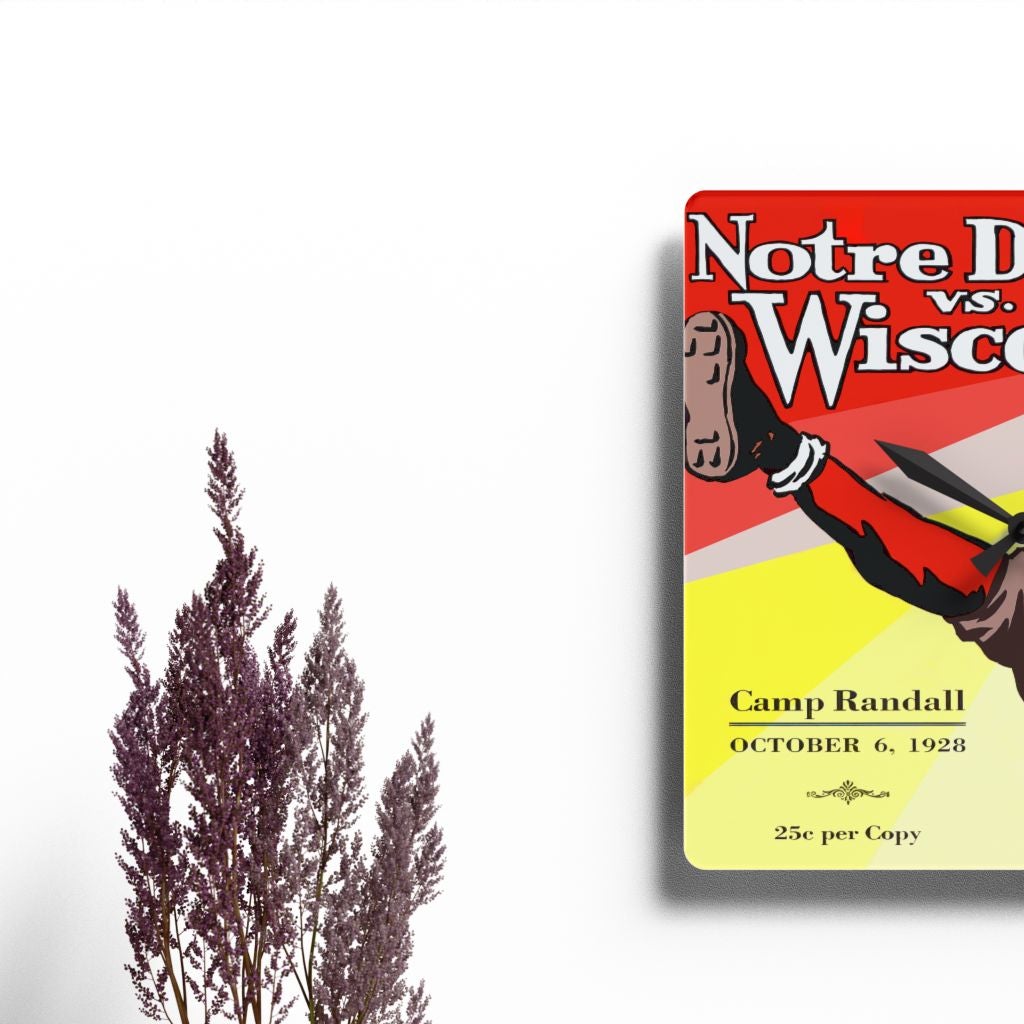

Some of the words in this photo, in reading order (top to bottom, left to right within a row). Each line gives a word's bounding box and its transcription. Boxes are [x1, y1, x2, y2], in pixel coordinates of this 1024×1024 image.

[687, 213, 949, 291] Notre
[926, 289, 1017, 313] vs.
[730, 689, 825, 719] Camp
[833, 689, 966, 712] Randall
[730, 737, 861, 753] OCTOBER
[874, 737, 895, 755] 6,
[908, 737, 966, 753] 1928
[774, 825, 814, 841] 25c
[821, 829, 859, 845] per
[865, 825, 922, 845] Copy
